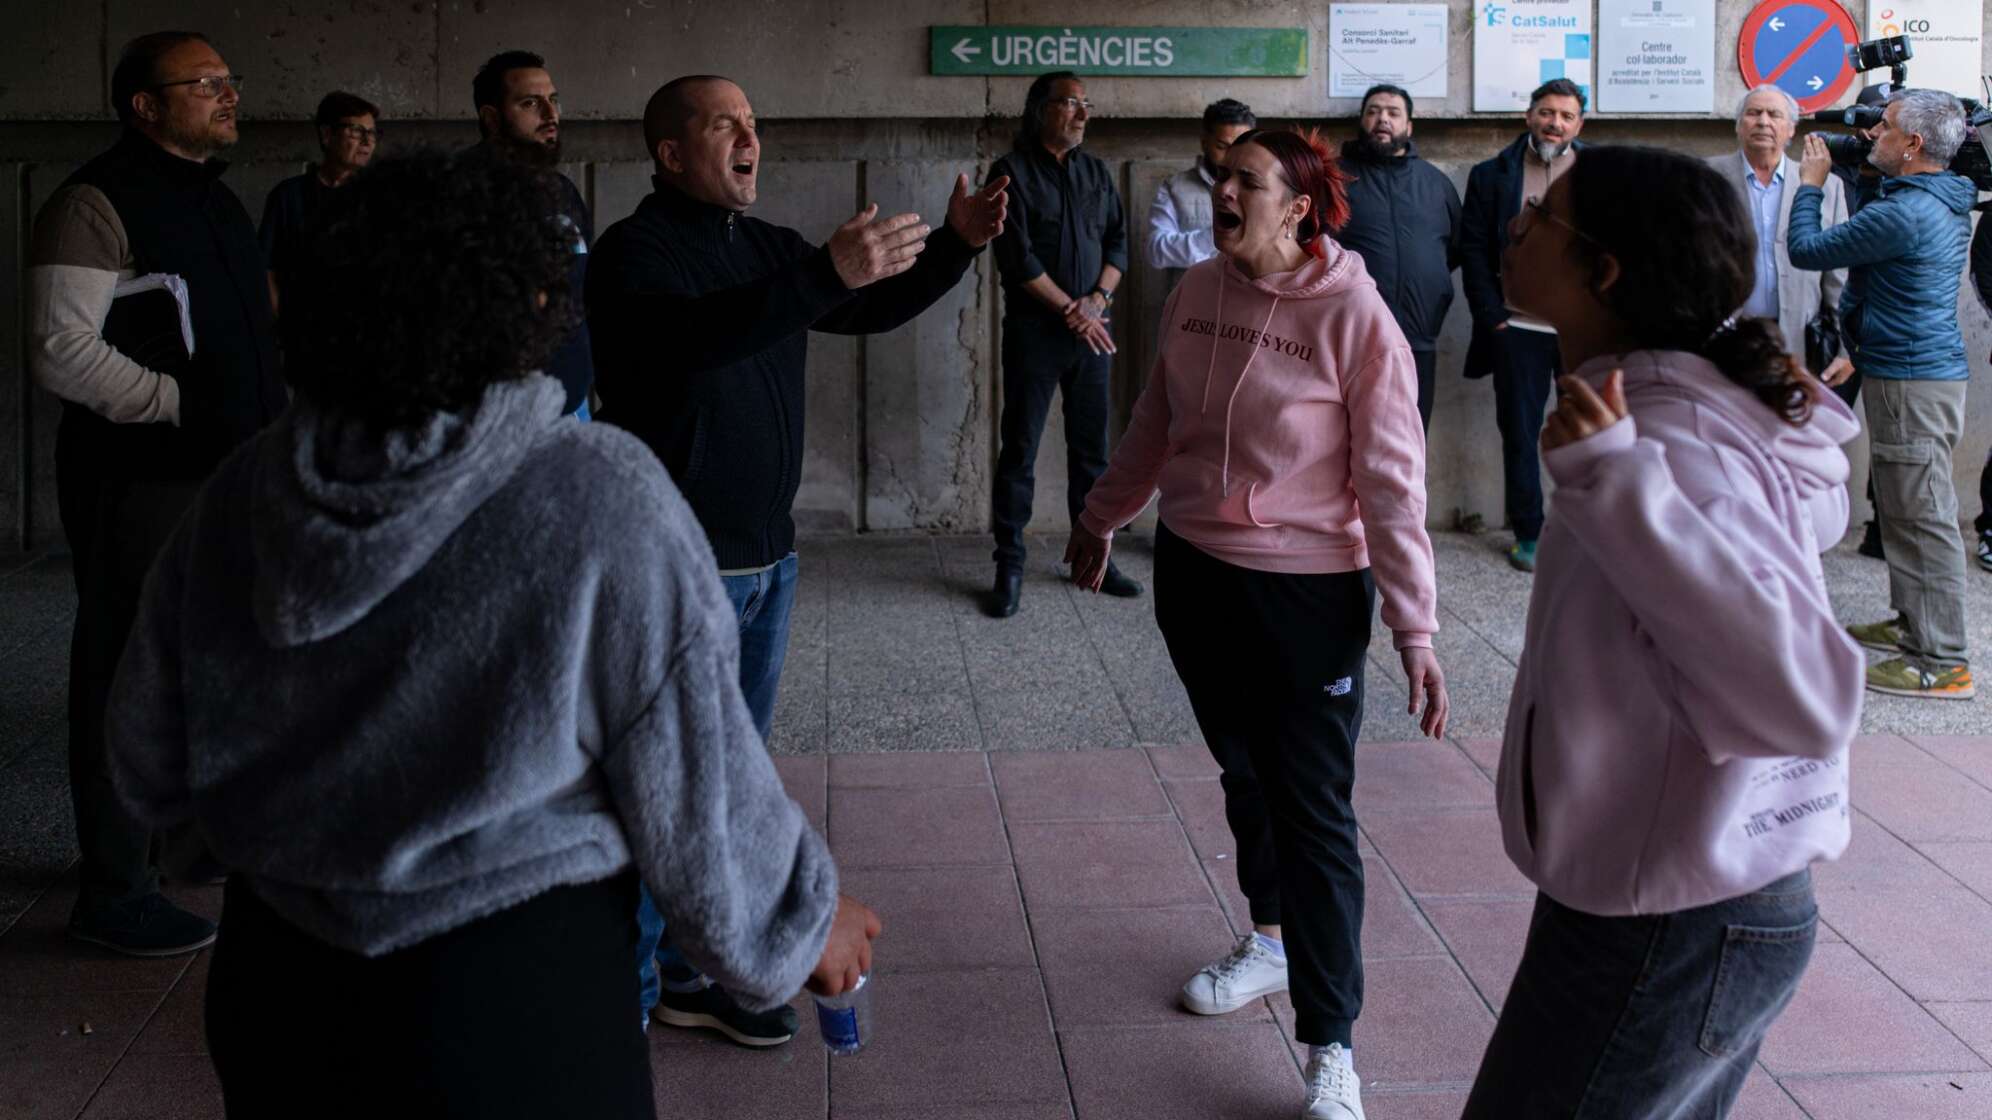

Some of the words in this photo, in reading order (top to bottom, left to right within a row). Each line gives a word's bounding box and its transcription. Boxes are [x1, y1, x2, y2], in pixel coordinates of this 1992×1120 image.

[1511, 15, 1577, 27] CatSalut
[1903, 19, 1930, 33] ICO
[1342, 28, 1377, 37] Consorci
[1379, 28, 1409, 37] Sanitari
[991, 28, 1173, 66] URGÈNCIES
[1342, 37, 1354, 45] Alt
[1641, 41, 1672, 53] Centre
[1219, 322, 1272, 349] LOVES
[1273, 336, 1313, 362] YOU
[1743, 818, 1773, 838] THE
[1774, 792, 1839, 826] MIDNIGHT
